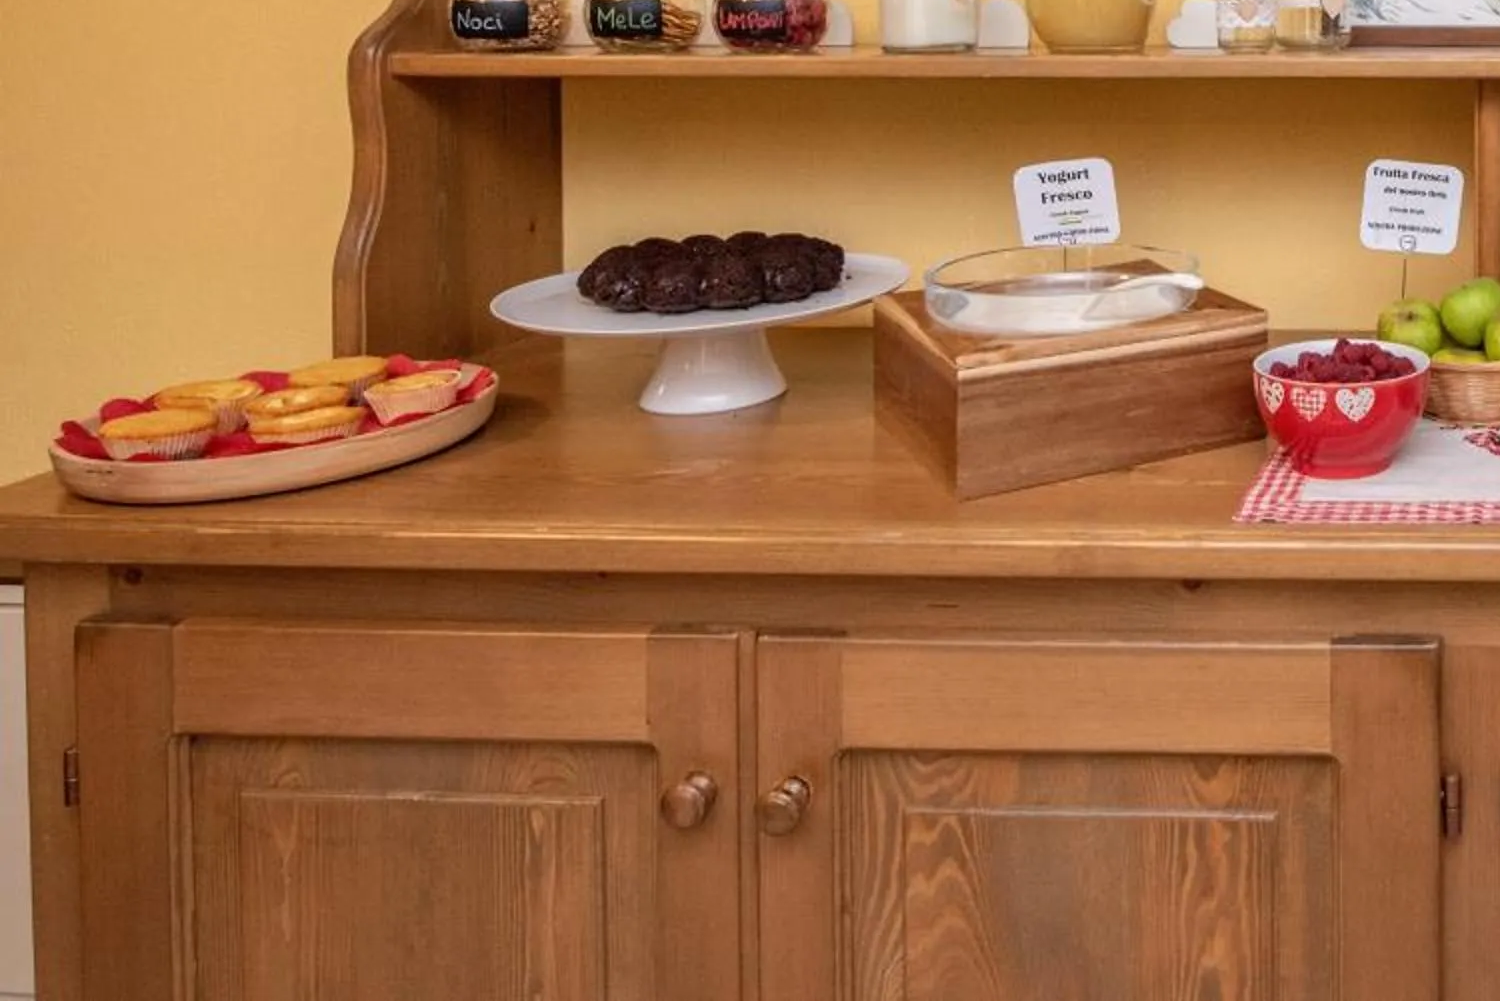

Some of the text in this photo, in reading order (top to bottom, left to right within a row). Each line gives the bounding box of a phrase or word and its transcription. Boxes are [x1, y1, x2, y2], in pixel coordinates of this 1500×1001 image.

[456, 7, 503, 31] Noci
[1037, 167, 1090, 185] Yogurt
[1373, 165, 1450, 184] Frutta Fresca
[1040, 189, 1094, 205] Fresco
